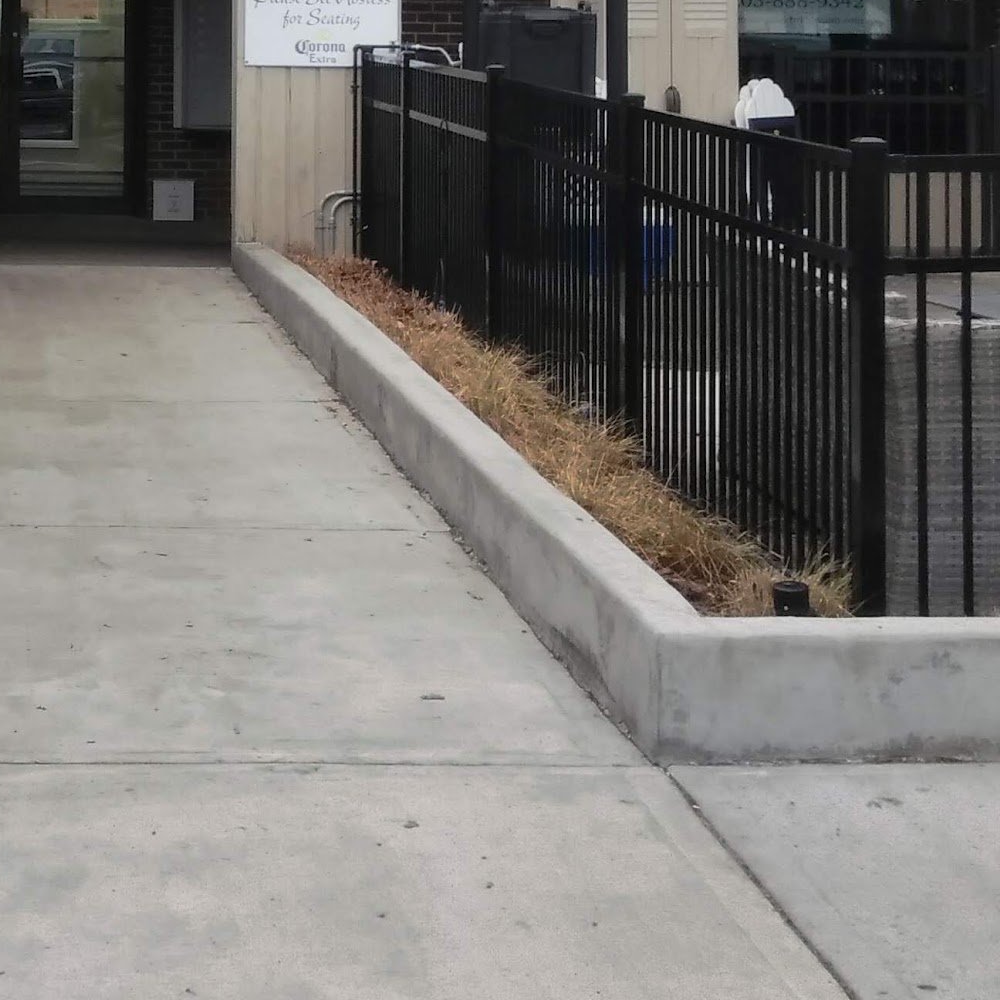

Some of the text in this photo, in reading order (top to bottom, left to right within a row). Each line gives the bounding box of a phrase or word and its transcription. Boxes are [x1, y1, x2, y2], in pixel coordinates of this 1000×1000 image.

[282, 7, 361, 30] for Seating
[295, 38, 346, 56] Corona
[309, 54, 337, 64] Extra
